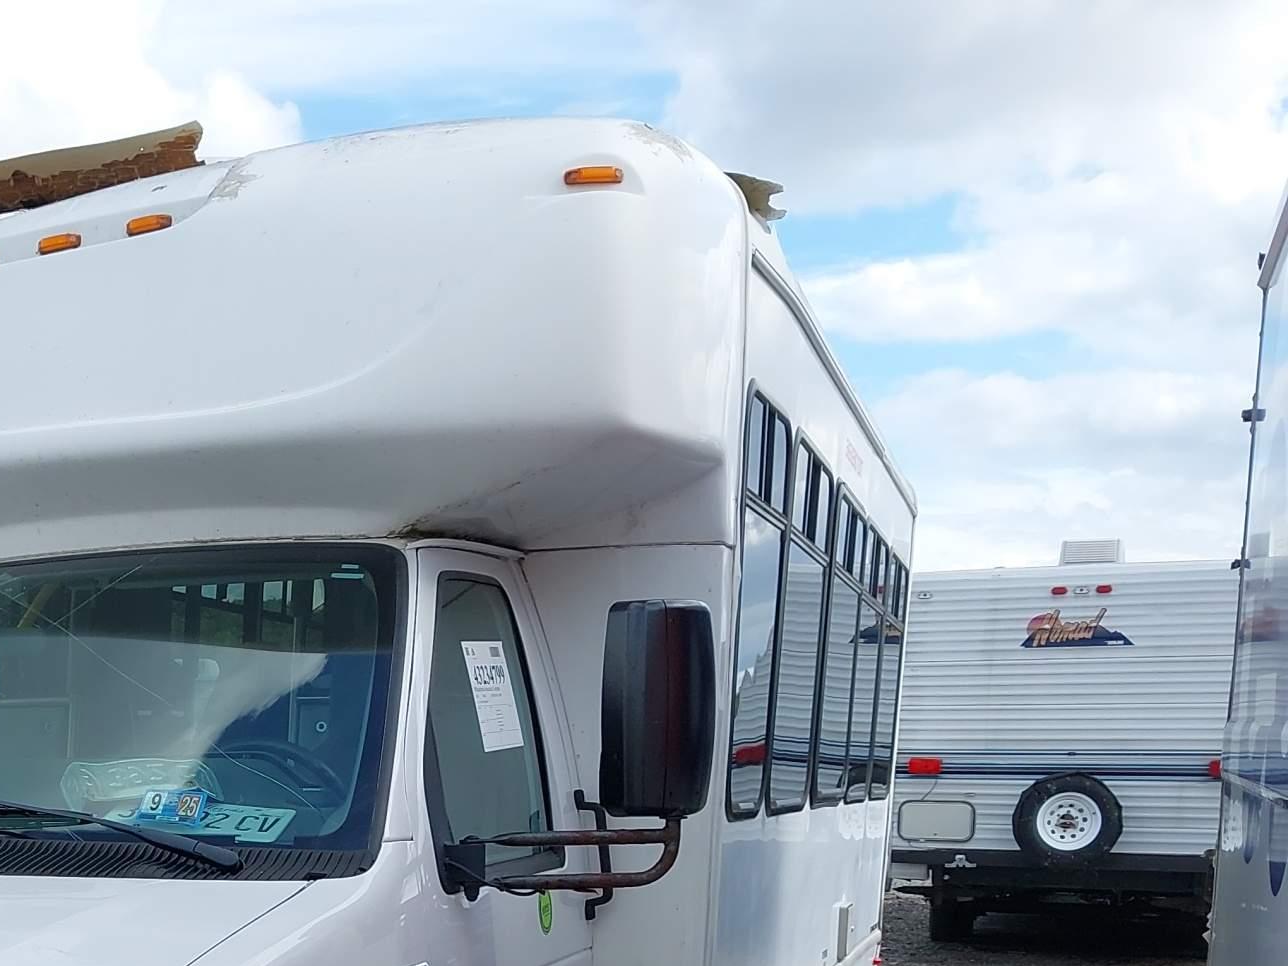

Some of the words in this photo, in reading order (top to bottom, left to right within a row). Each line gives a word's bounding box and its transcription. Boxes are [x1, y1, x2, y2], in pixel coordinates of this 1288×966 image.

[1033, 608, 1107, 647] Nomad
[472, 664, 506, 686] 43234799
[149, 793, 162, 811] 9
[178, 796, 200, 817] 25
[235, 815, 281, 833] CV
